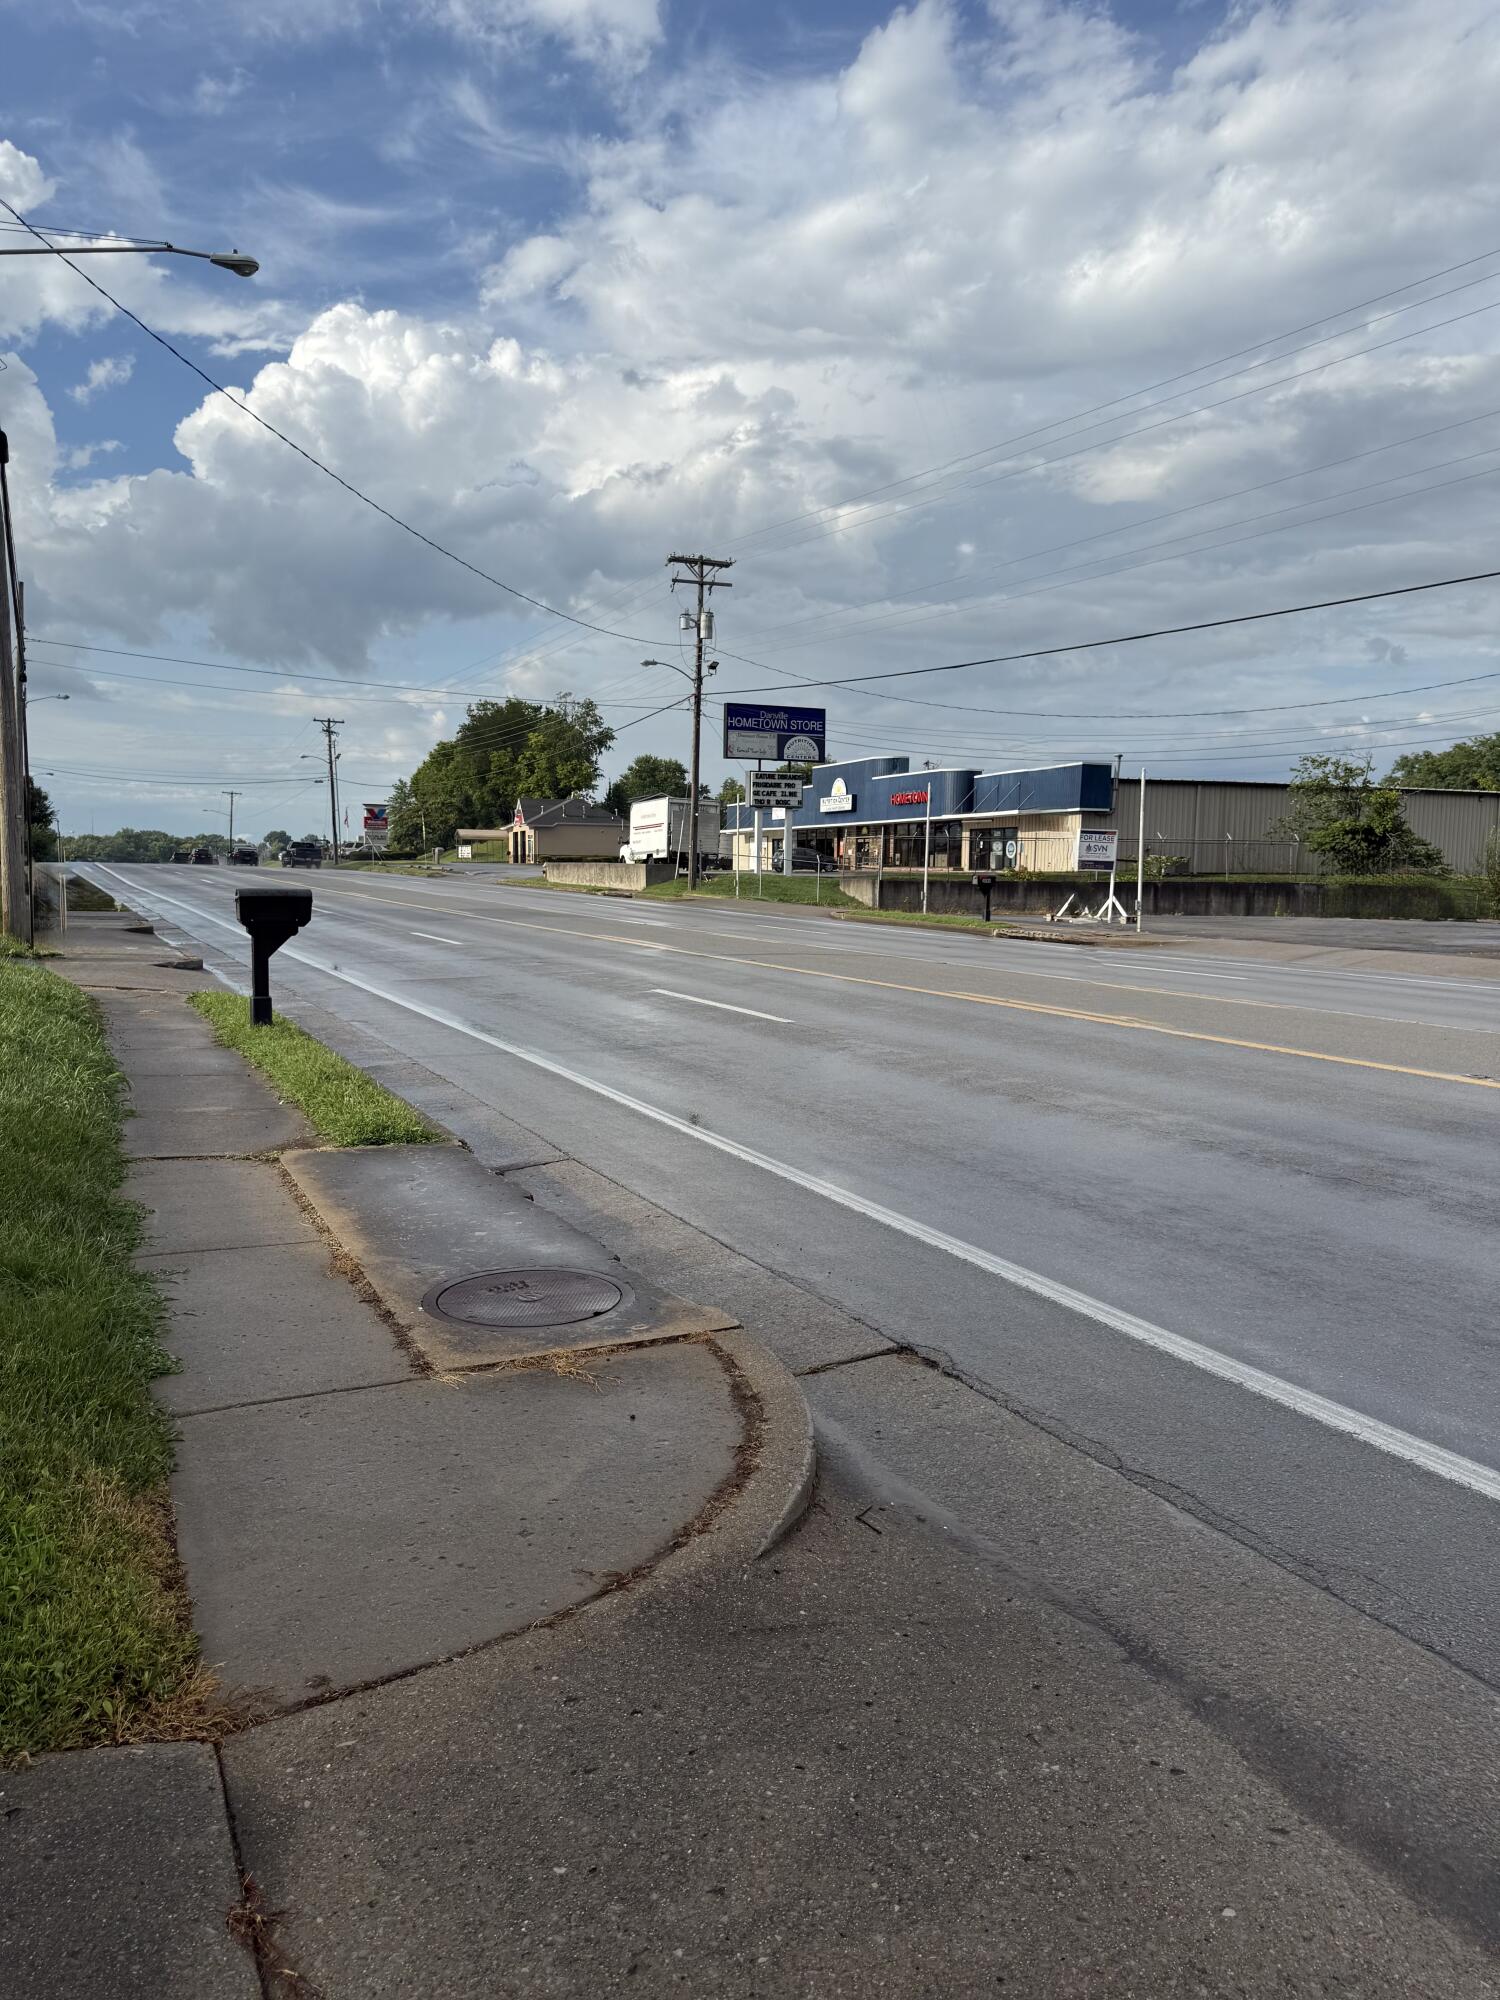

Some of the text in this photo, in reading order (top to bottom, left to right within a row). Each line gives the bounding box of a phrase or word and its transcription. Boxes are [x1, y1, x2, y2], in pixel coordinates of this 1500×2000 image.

[760, 710, 789, 720] Danville
[728, 716, 824, 732] HOMETOWN STORE
[787, 738, 816, 752] NUTRITION
[890, 791, 929, 806] HOMETOWN
[1093, 844, 1108, 852] SVN
